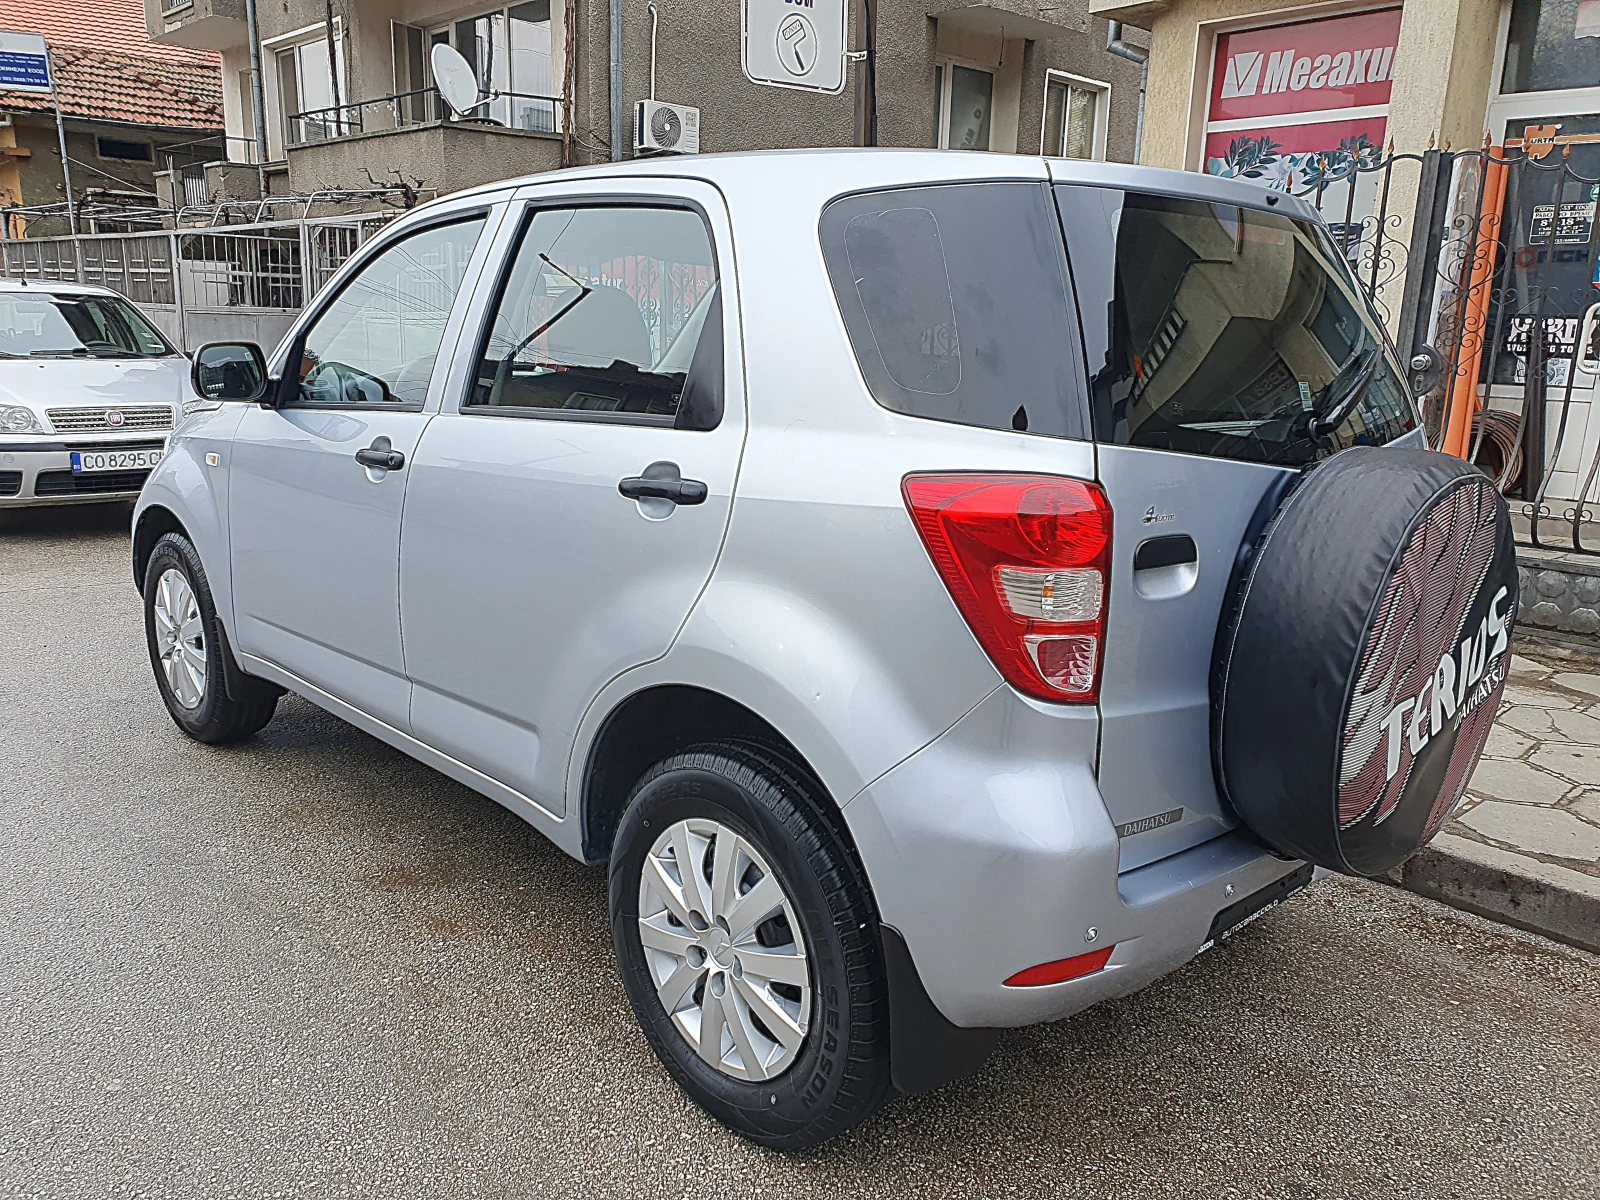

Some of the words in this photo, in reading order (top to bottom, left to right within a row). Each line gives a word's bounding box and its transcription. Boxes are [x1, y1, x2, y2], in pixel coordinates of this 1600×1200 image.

[1262, 46, 1396, 95] Мегахи
[108, 452, 147, 468] 8295
[1453, 663, 1506, 732] DAIHATSU
[1124, 812, 1172, 836] DAIHATSU
[802, 983, 840, 1110] SEASON
